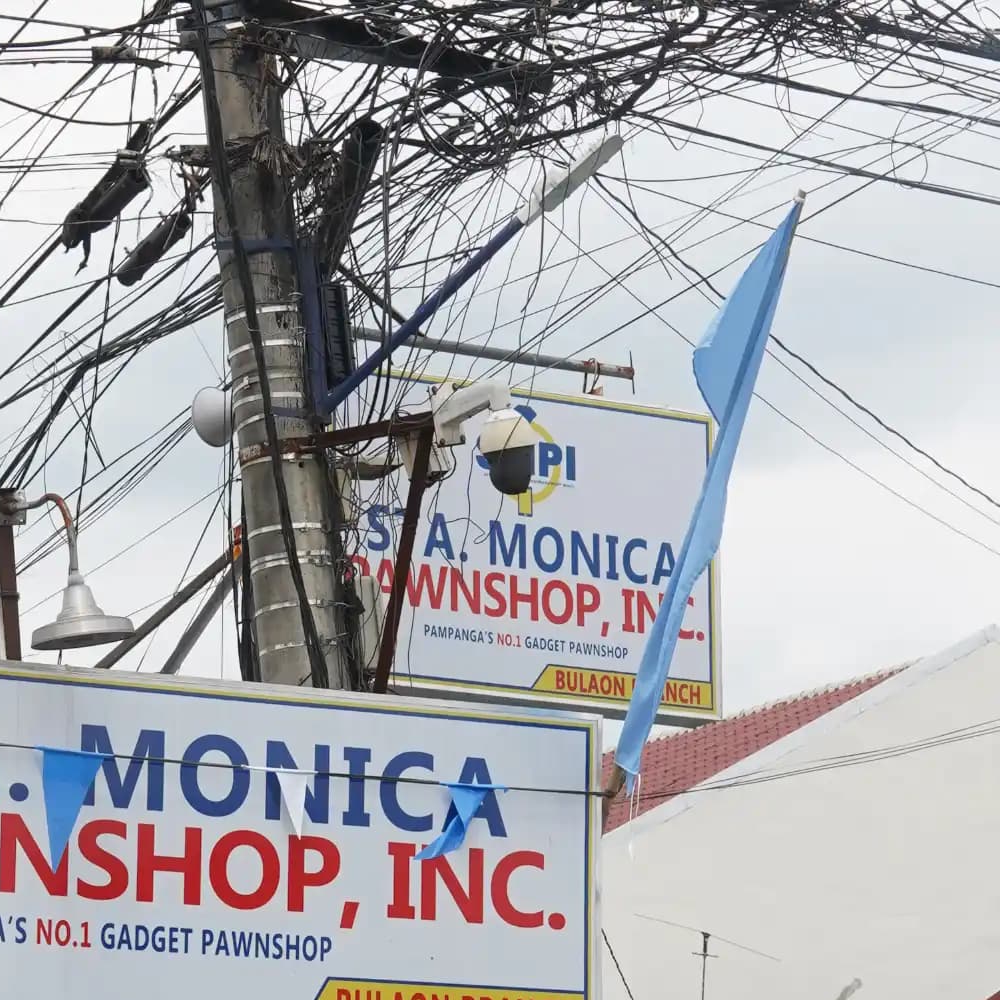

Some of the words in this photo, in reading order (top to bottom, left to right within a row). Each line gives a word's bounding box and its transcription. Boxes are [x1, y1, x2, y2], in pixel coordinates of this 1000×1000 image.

[489, 519, 676, 586] MONICA
[423, 624, 494, 645] PAMPANGA'S
[496, 634, 522, 649] NO.1
[525, 636, 566, 654] GADGET
[569, 640, 629, 660] PAWNSHOP
[555, 670, 625, 697] BULAON
[632, 677, 701, 704] NCH
[81, 723, 508, 838] MONICA
[387, 840, 567, 931] INC.
[36, 917, 93, 948] NO.1
[100, 922, 193, 955] GADGET
[201, 928, 333, 962] PAWNSHOP
